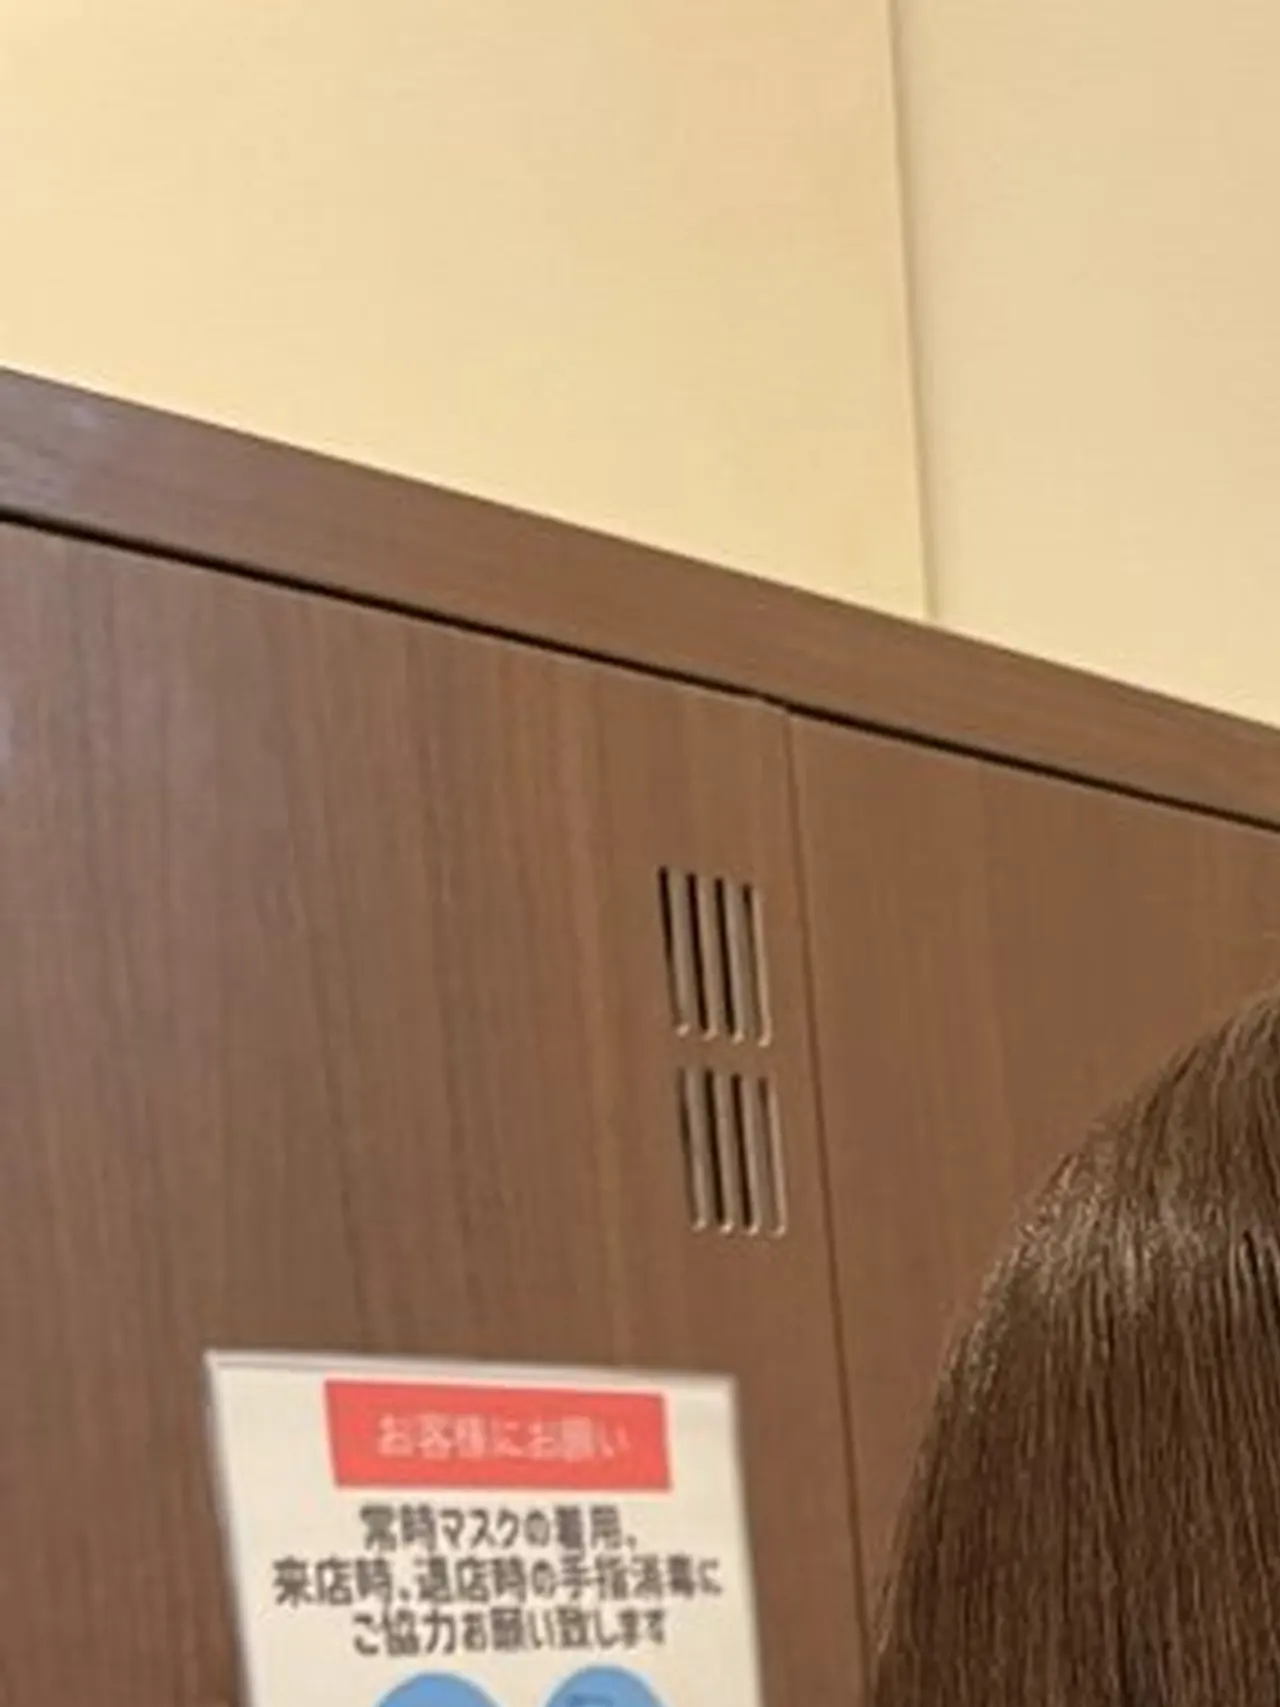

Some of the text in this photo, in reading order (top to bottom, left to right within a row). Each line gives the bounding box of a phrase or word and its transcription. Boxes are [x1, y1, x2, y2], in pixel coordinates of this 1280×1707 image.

[378, 1413, 632, 1463] お客様にお願い
[352, 1605, 667, 1657] ご協力お願い致します
